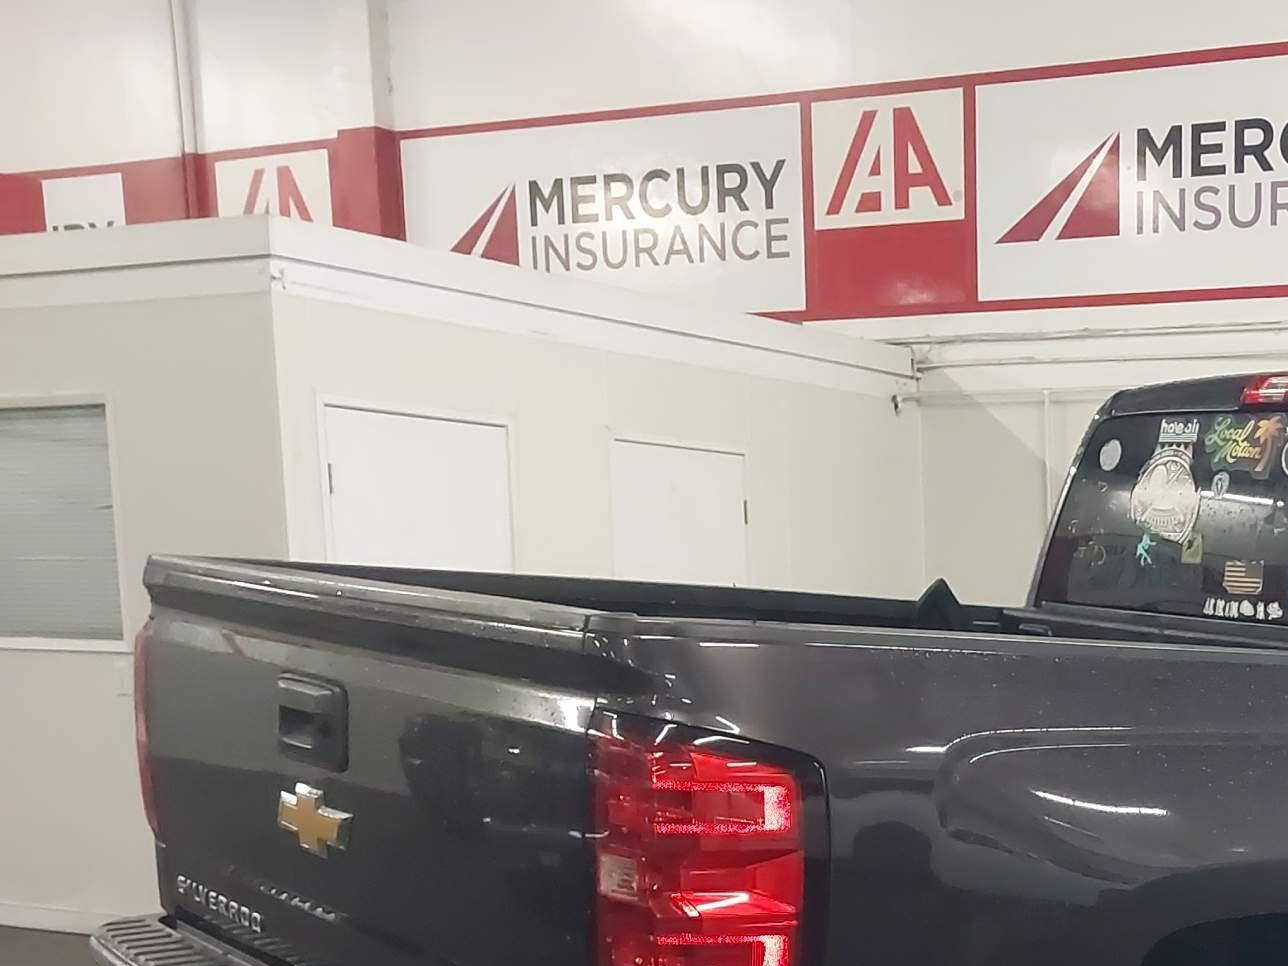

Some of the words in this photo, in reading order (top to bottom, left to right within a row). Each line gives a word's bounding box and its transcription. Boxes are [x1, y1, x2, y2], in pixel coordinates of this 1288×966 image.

[528, 159, 786, 227] MERCURY
[531, 218, 791, 272] INSURANCE
[1204, 417, 1256, 446] Local
[1213, 439, 1262, 464] Motion
[176, 874, 262, 934] SILVERADO
